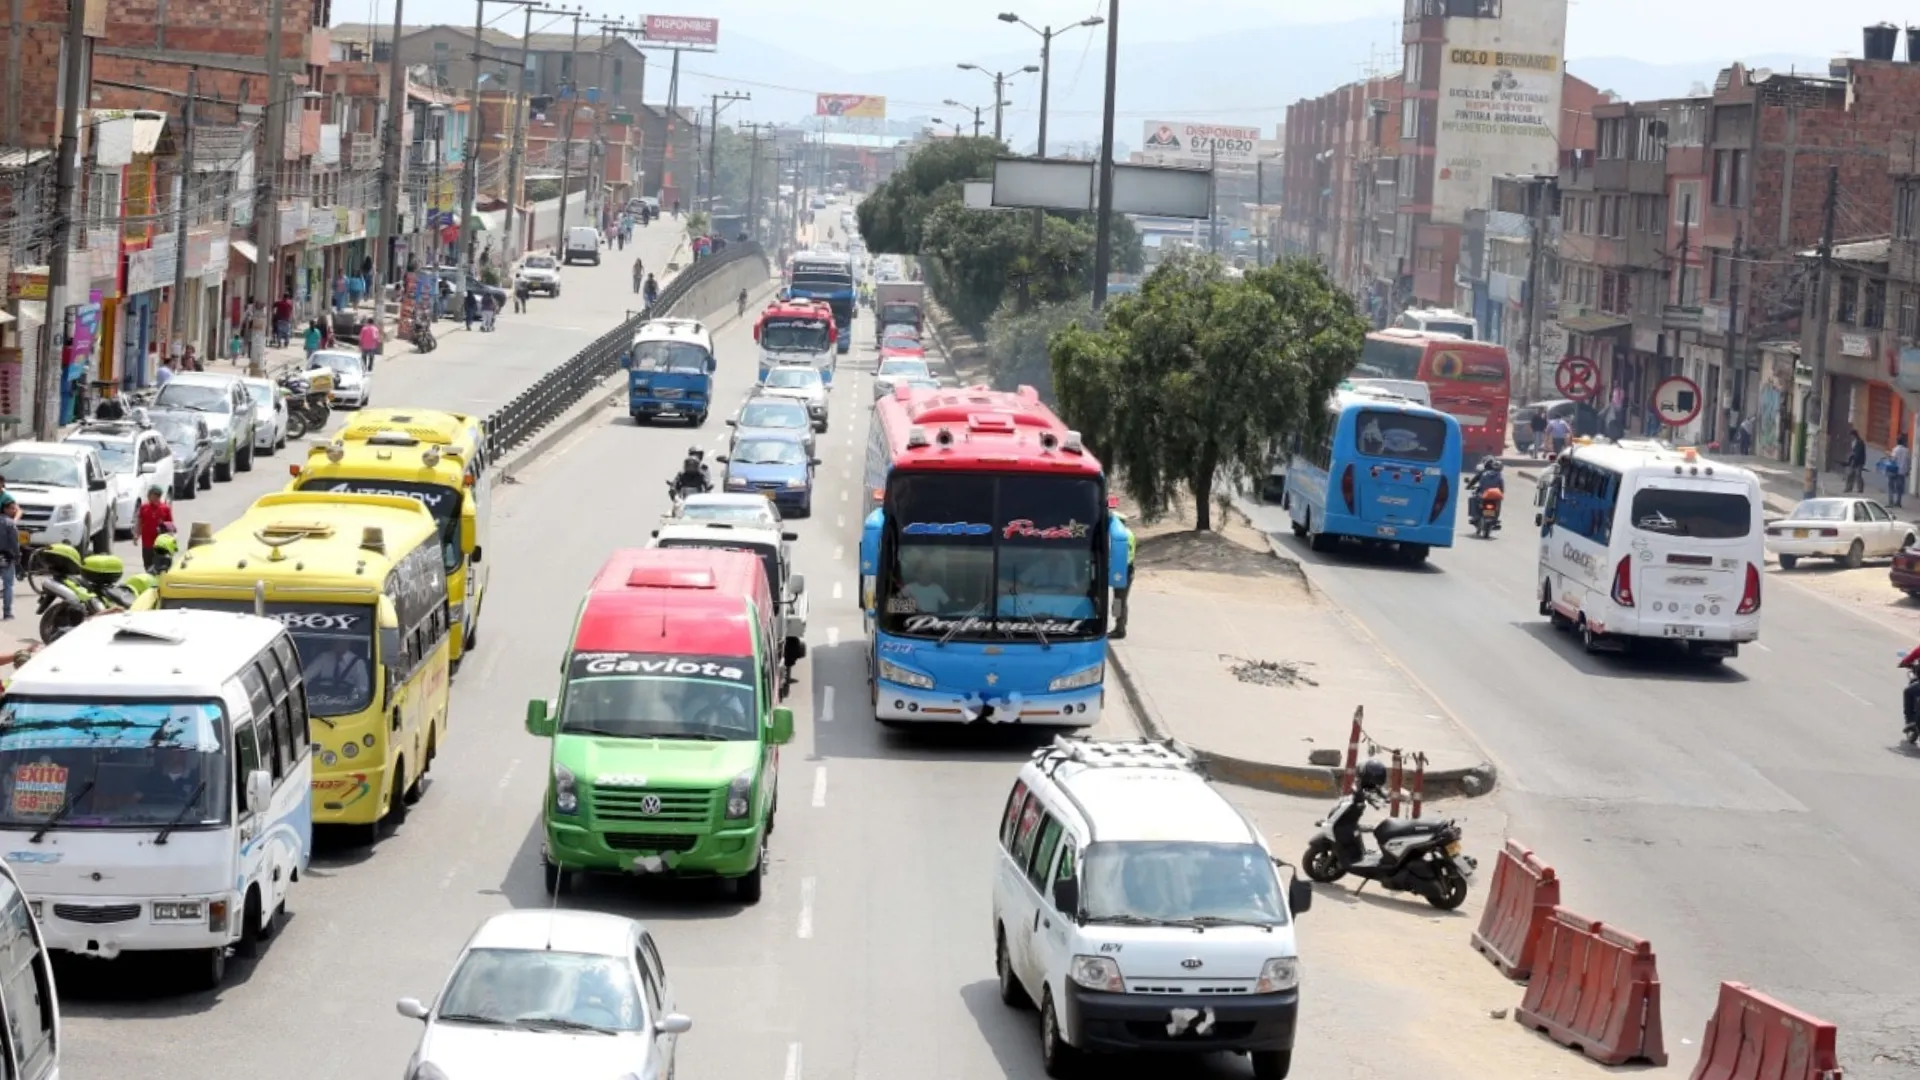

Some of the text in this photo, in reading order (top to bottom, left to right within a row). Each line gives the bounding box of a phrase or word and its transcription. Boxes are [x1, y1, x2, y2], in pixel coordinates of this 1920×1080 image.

[653, 17, 713, 32] DISPONIBLE
[1451, 49, 1488, 65] CICLO
[1449, 87, 1495, 100] BICICLETAS
[1454, 109, 1491, 121] PINTURA
[1185, 125, 1258, 140] DISPONIBLE
[1442, 121, 1498, 134] IMPLEMENTOS
[904, 615, 1083, 634] Preferencial
[586, 657, 744, 681] Gaviota
[17, 767, 67, 784] EXITO
